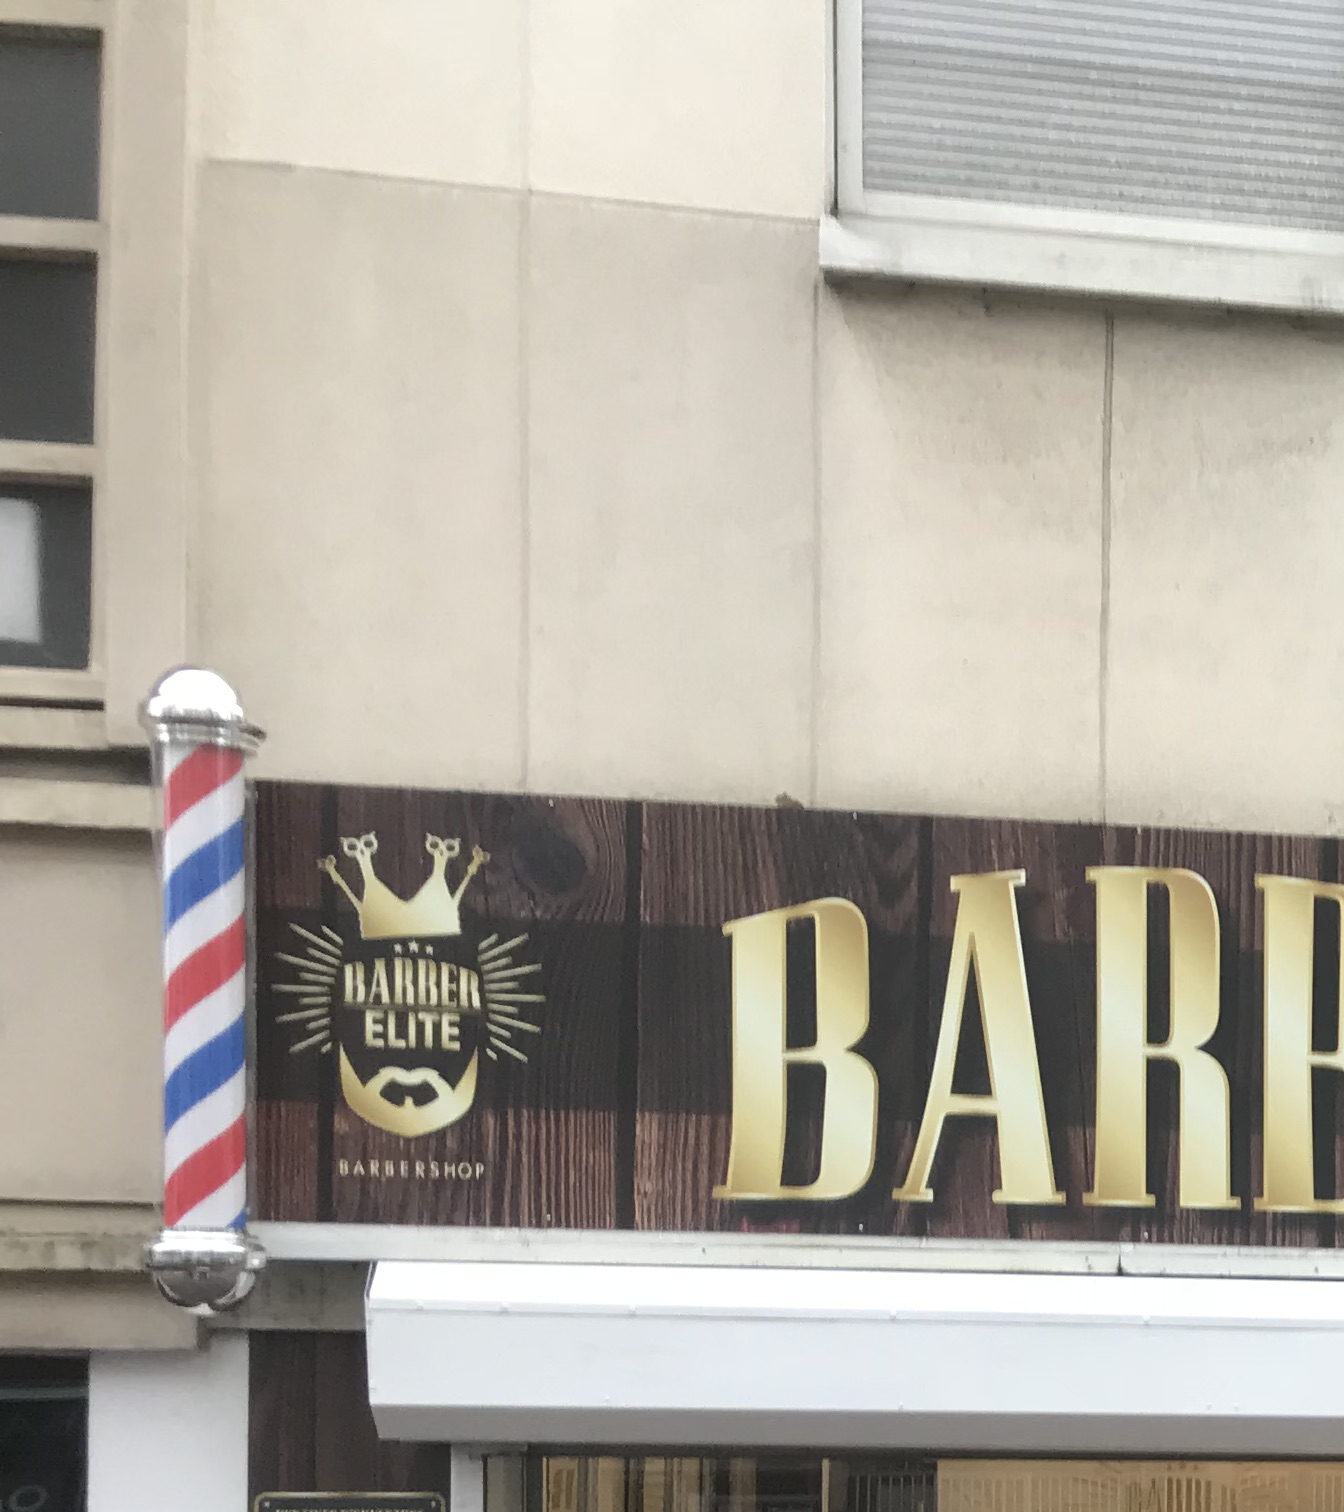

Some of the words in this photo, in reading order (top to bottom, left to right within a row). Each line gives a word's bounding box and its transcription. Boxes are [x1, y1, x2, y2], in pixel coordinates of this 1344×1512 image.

[343, 957, 481, 1010] BARBER
[364, 1011, 461, 1052] ELITE
[338, 1158, 485, 1181] BARBERSHOP
